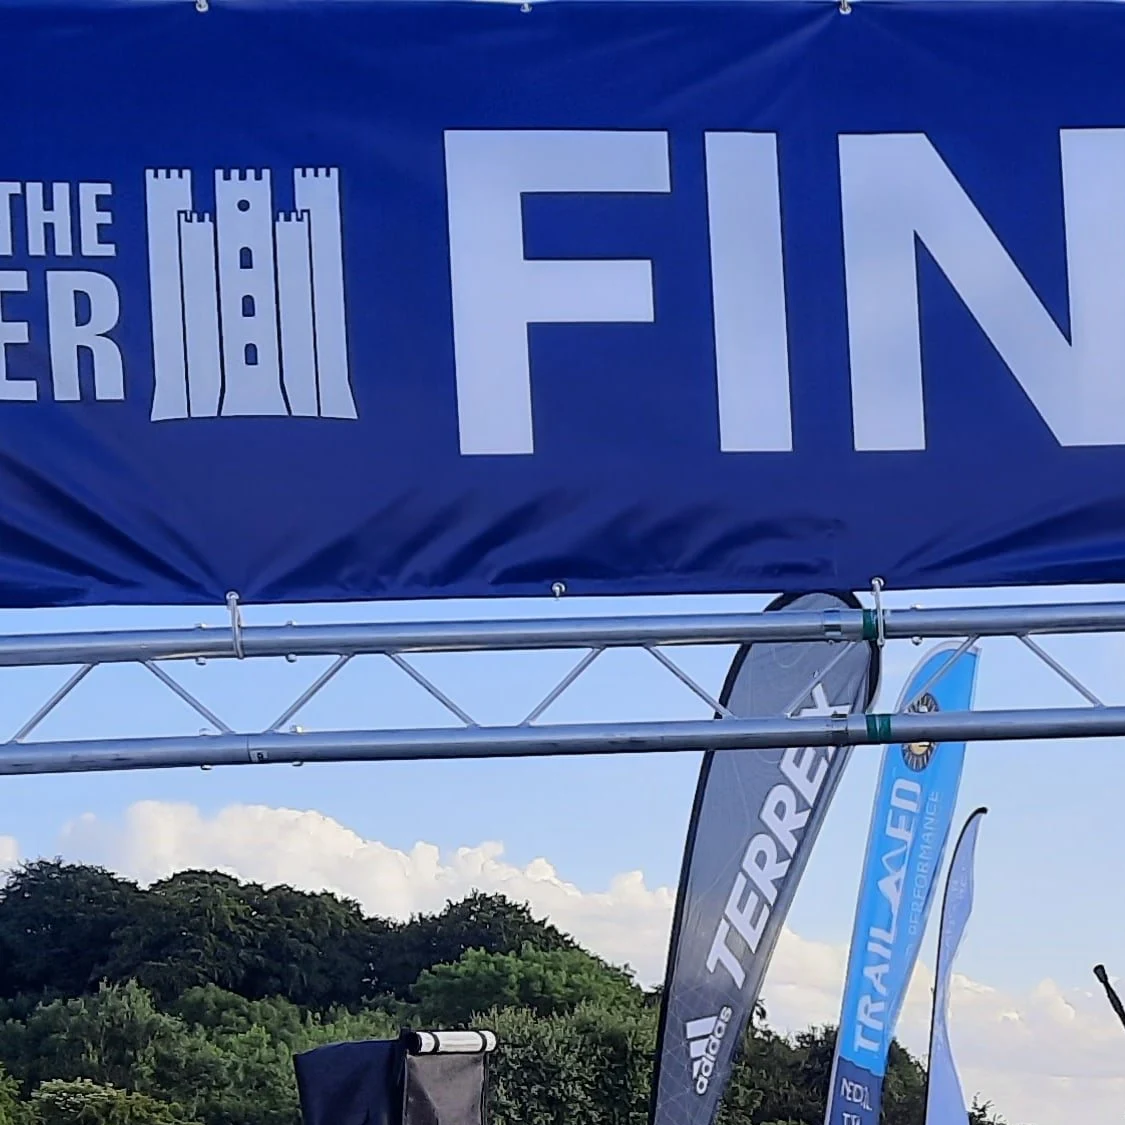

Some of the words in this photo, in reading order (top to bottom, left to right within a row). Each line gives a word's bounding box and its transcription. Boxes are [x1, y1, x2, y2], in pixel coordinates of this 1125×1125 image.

[0, 181, 117, 257] THE
[706, 680, 852, 990] TERREX
[695, 1005, 733, 1095] adidas
